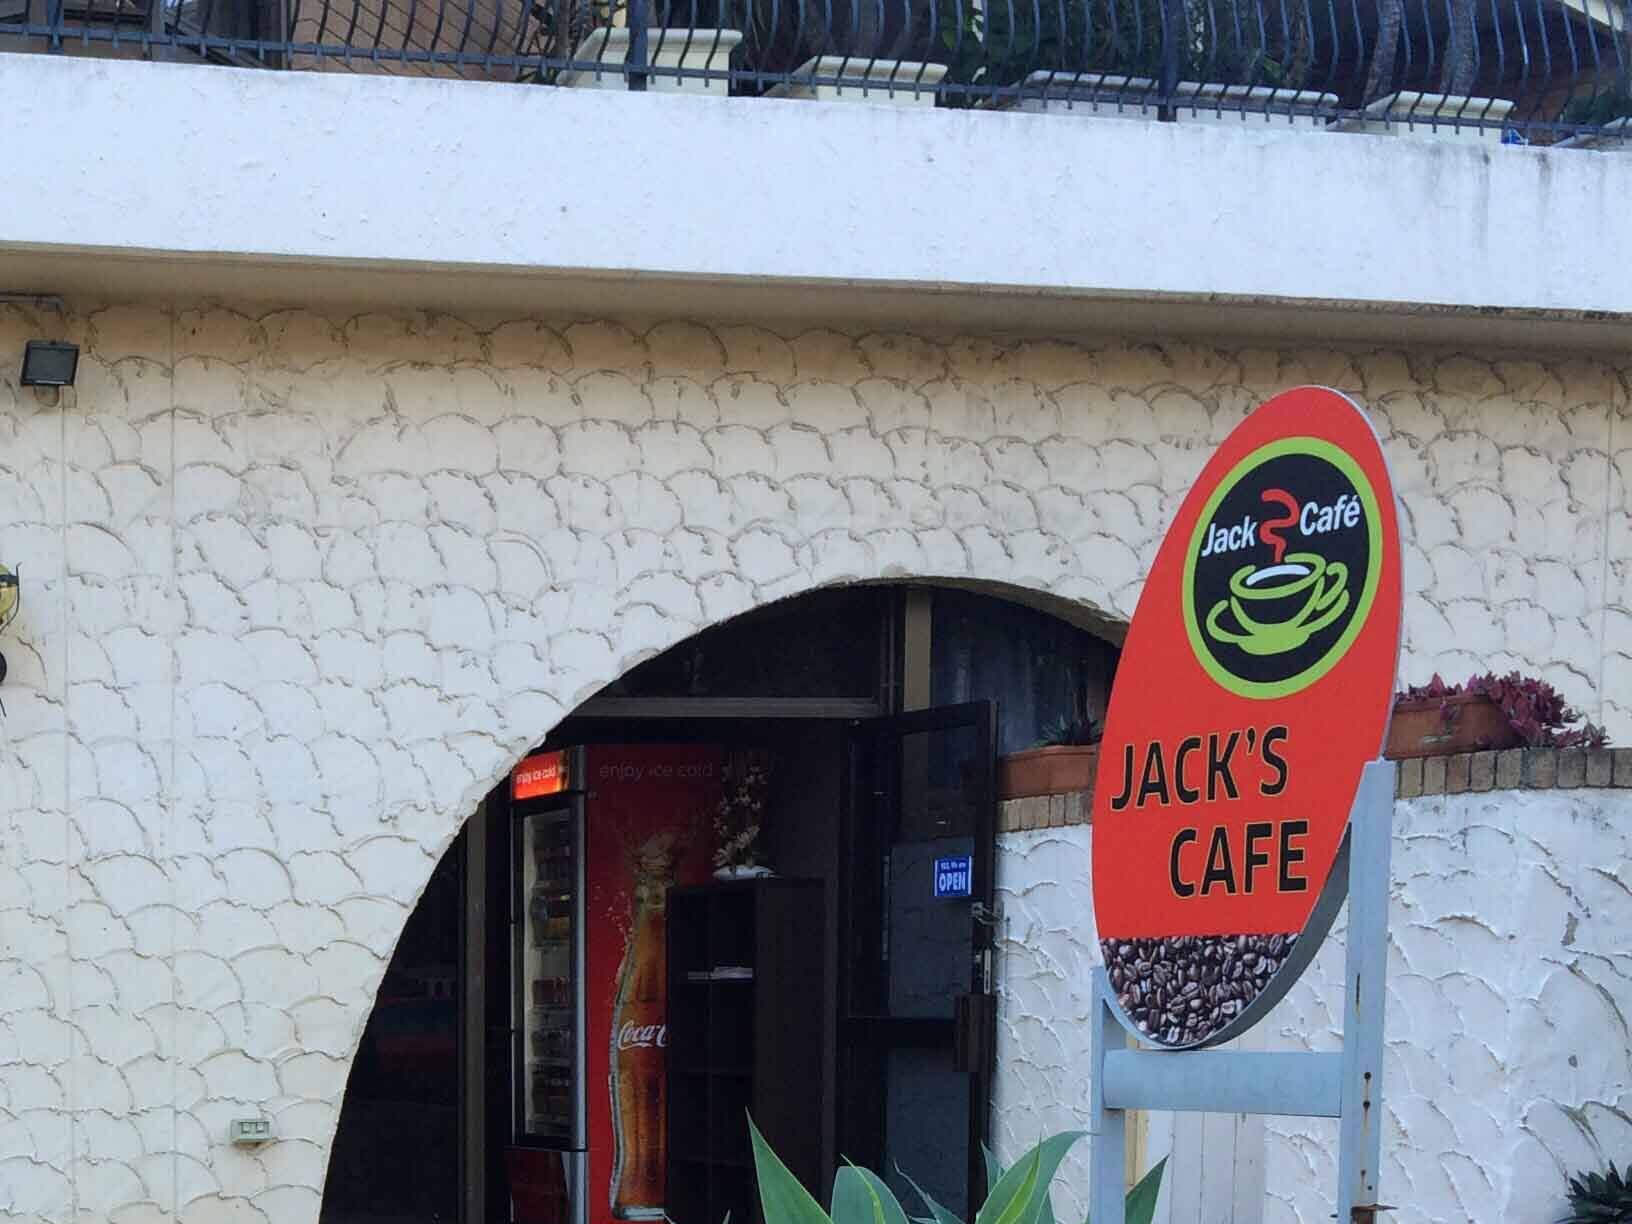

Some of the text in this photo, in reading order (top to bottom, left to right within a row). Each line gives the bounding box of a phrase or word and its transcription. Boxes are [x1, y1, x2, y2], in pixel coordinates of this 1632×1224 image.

[1201, 494, 1360, 557] Jack Café
[600, 759, 713, 784] enjoy ice cold
[1111, 723, 1290, 813] JACK'S
[938, 871, 966, 892] OPEN
[1168, 818, 1309, 899] CAFE
